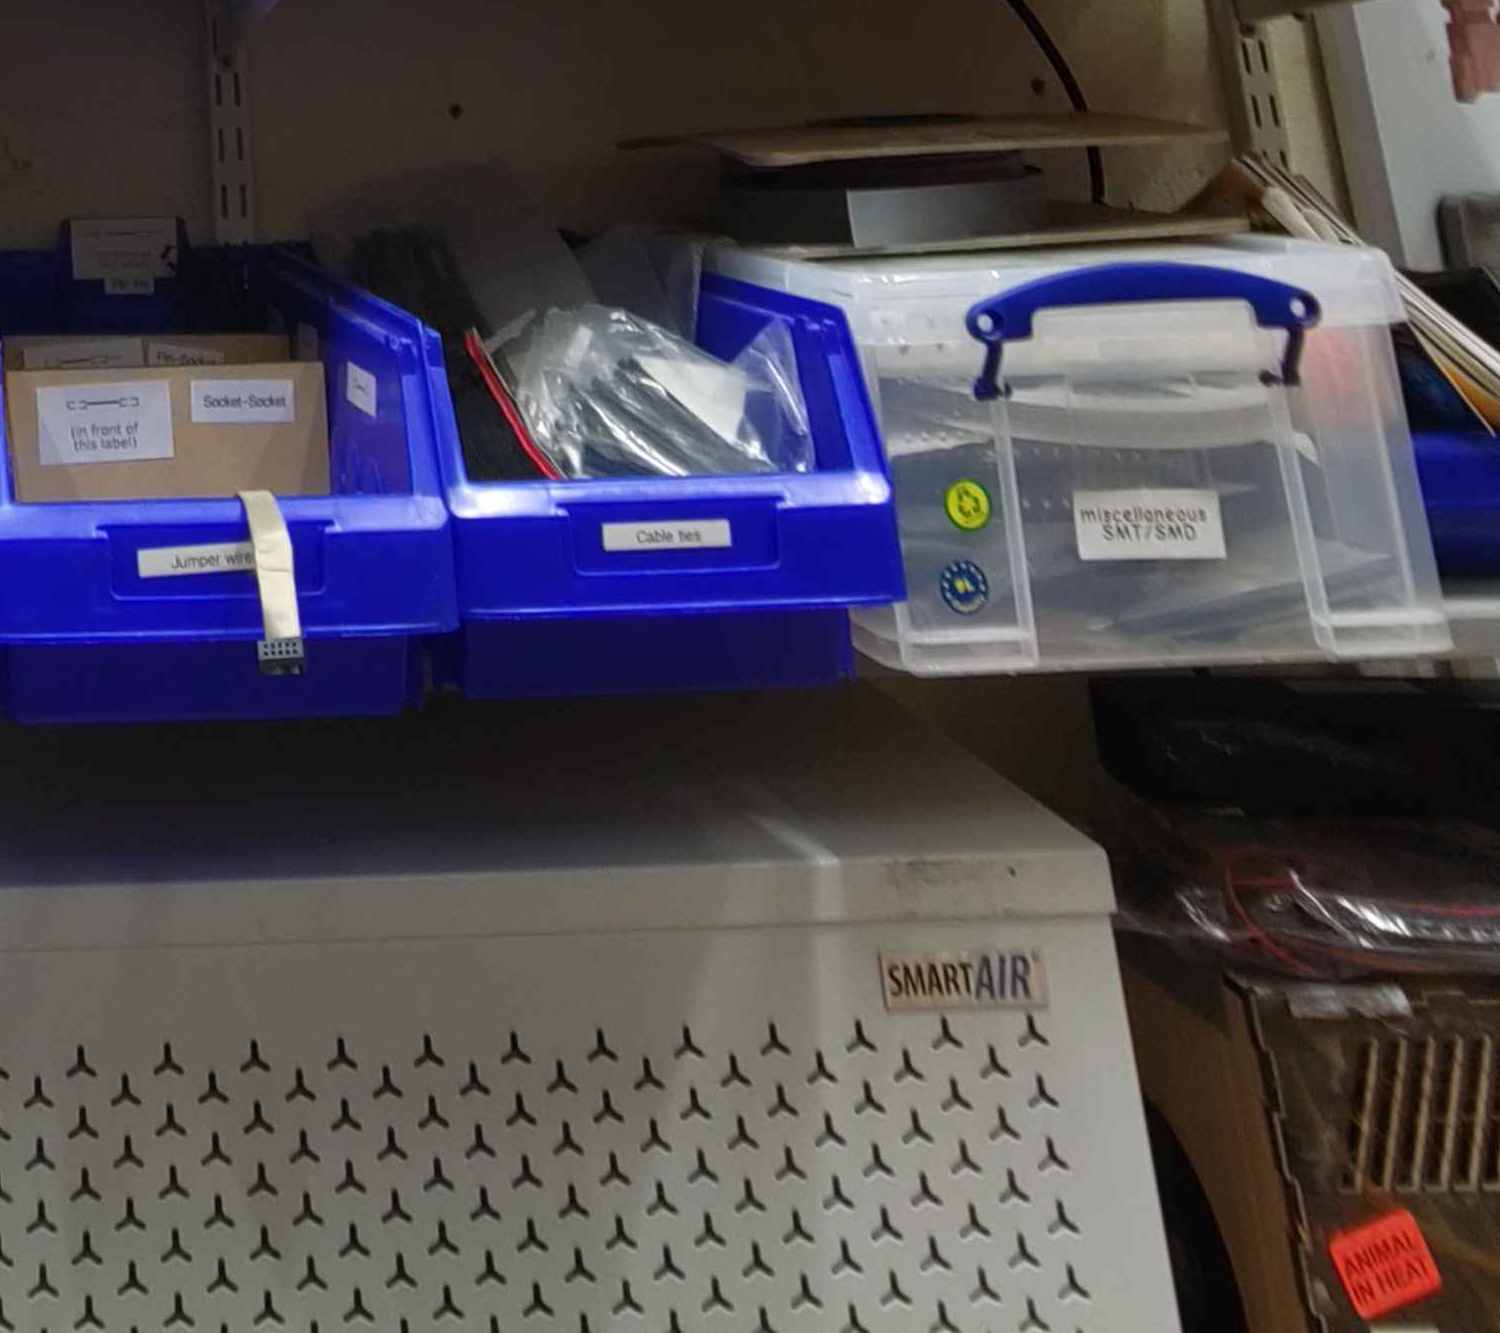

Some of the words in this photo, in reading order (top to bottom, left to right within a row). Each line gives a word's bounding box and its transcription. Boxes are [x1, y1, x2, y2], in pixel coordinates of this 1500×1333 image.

[203, 395, 287, 409] Socket-Socket
[70, 426, 88, 440] (in
[91, 425, 123, 437] front
[74, 438, 97, 452] this
[100, 435, 138, 451] label)
[1080, 505, 1209, 523] miscellaneous
[635, 528, 674, 545] Cable
[676, 528, 703, 545] ties
[1102, 523, 1198, 542] SMT/SMD
[171, 551, 220, 570] Jumper
[888, 954, 1032, 1000] SMARTAIR
[1343, 1229, 1416, 1279] ANIMAL
[1377, 1253, 1432, 1292] HEAT
